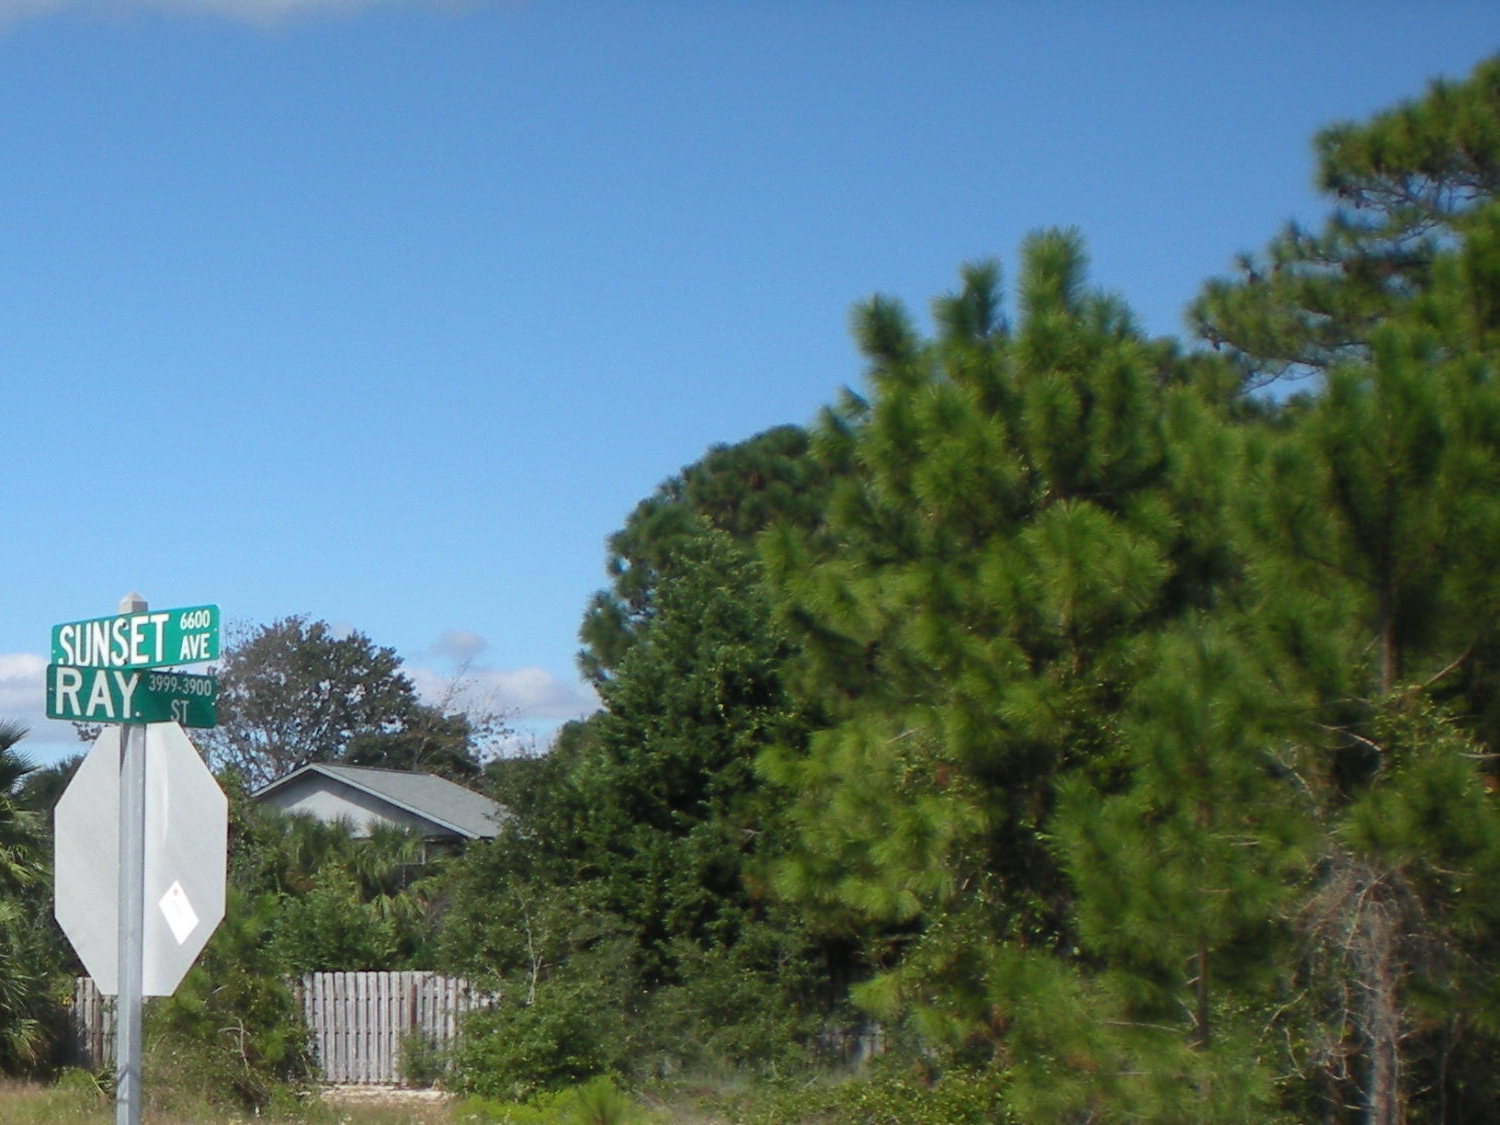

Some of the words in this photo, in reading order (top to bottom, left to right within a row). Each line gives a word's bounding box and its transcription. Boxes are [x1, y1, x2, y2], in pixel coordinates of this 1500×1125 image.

[180, 610, 210, 630] 6600
[58, 614, 169, 667] SUNSET
[180, 634, 210, 660] AVE
[56, 667, 139, 719] RAY
[148, 675, 212, 696] 3999-3900
[170, 700, 190, 724] ST
